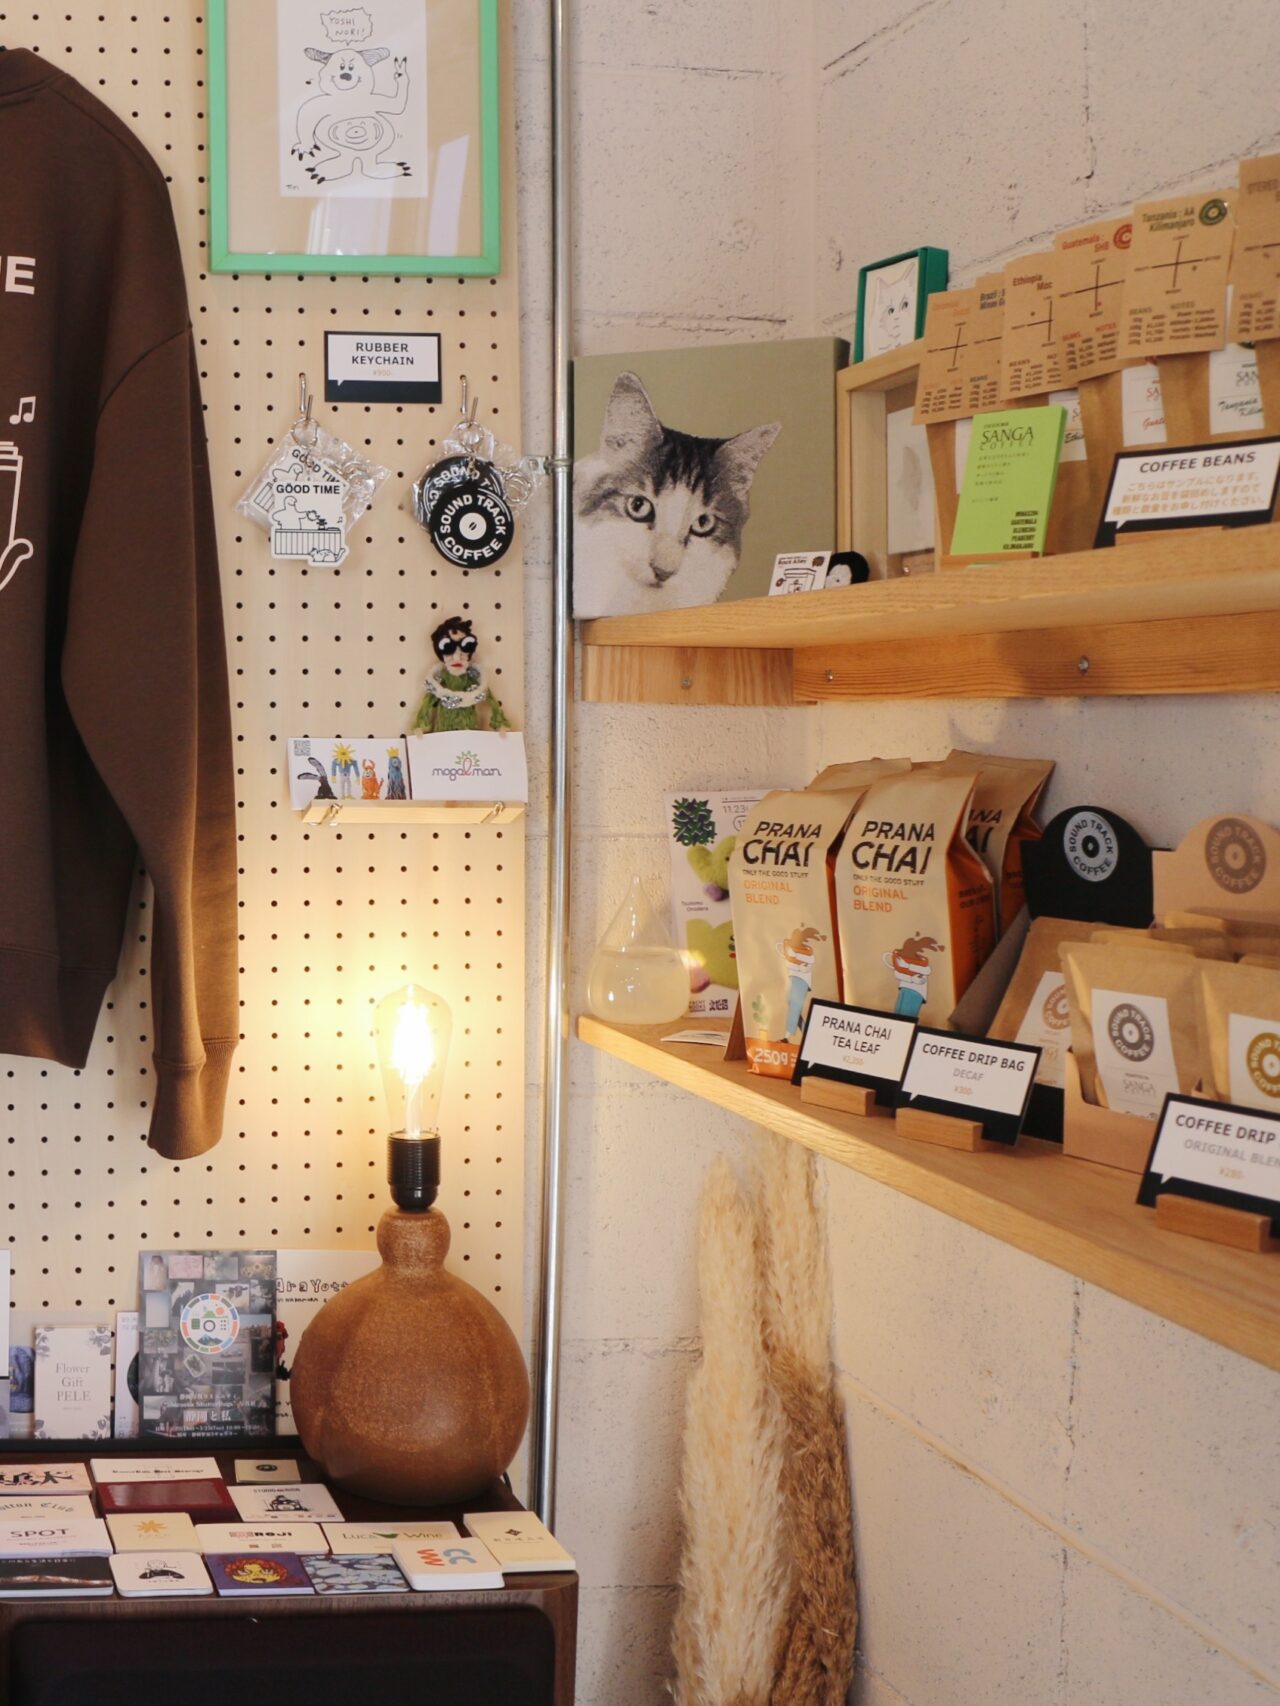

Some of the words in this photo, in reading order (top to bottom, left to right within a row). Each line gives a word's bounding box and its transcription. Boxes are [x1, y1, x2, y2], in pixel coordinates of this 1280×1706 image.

[328, 17, 356, 26] YOSHI
[335, 28, 365, 36] NORI!
[1142, 211, 1177, 222] Tanzania
[1184, 207, 1195, 216] AA
[1061, 234, 1100, 250] Guatemala
[356, 342, 409, 352] RUBBER
[351, 355, 415, 366] KEYCHAIN
[981, 426, 1034, 446] SANGA
[1139, 457, 1198, 474] COFFEE
[1202, 451, 1256, 468] BEANS
[276, 482, 310, 494] GÖOD
[313, 484, 341, 495] TIME
[440, 494, 473, 534] SOUND
[476, 494, 507, 536] TRACK
[444, 536, 503, 561] COFFEE
[753, 821, 822, 838] PRANA
[860, 820, 935, 842] PRANA
[1069, 819, 1087, 853] SOUND
[1090, 819, 1114, 854] TRACK
[742, 839, 815, 868] CHAI
[1211, 826, 1233, 864] SOUND
[1235, 826, 1262, 864] TRACK
[851, 841, 932, 875] CHAI
[1073, 856, 1113, 876] COFFEE
[770, 870, 788, 878] GOOD
[789, 871, 809, 879] STUFF
[870, 875, 881, 883] THE
[884, 877, 902, 886] GOOD
[903, 878, 925, 887] STUFF
[1215, 866, 1259, 890] COFFEE
[743, 879, 793, 893] ORIGINAL
[853, 885, 908, 901] ORIGINAL
[745, 893, 780, 905] BLEND
[853, 900, 893, 913] BLEND
[822, 1015, 862, 1034] PRANA
[864, 1023, 892, 1040] CHAI
[1111, 1008, 1130, 1037] SOUND
[1130, 1010, 1152, 1041] TRACK
[832, 1035, 852, 1050] TEA
[854, 1040, 881, 1055] LEAF
[1115, 1039, 1150, 1059] COFFEE
[1249, 1038, 1272, 1069] SOUND
[922, 1042, 966, 1061] COFFEE
[968, 1051, 998, 1069] DRIP
[1000, 1058, 1025, 1072] BAG
[953, 1067, 985, 1082] DECAF
[1175, 1113, 1233, 1137] COFFEE
[1235, 1126, 1276, 1145] DRIP
[1184, 1138, 1247, 1161] ORIGINAL
[1249, 1152, 1280, 1168] BLEN
[55, 1362, 91, 1374] Flower
[61, 1377, 84, 1388] Gift
[57, 1390, 92, 1402] PELE
[10, 1529, 70, 1538] SPOT
